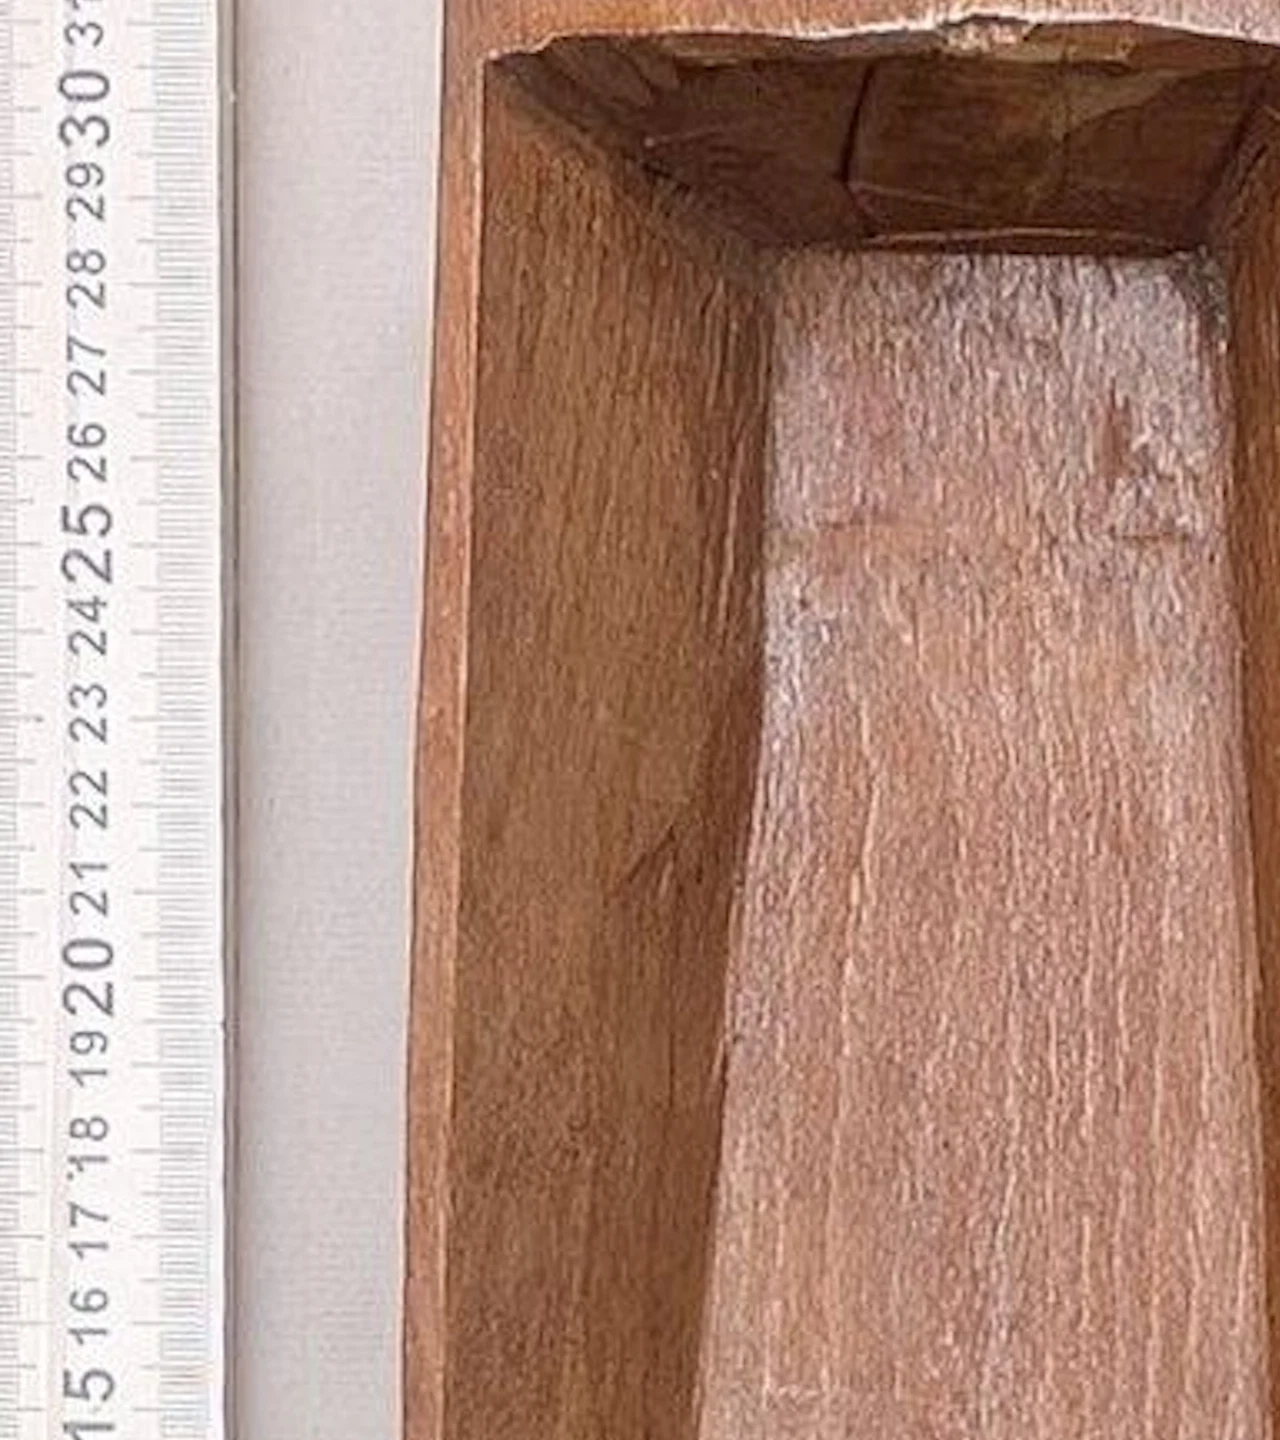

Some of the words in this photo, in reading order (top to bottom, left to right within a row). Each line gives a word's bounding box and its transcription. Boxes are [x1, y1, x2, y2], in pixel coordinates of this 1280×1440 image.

[57, 70, 110, 148] 30
[64, 162, 105, 222] 29
[66, 249, 106, 309] 28
[66, 334, 106, 397] 27
[66, 423, 107, 483] 26
[60, 504, 113, 584] 25
[66, 595, 107, 656] 24
[68, 683, 107, 744] 23
[68, 770, 108, 830] 22
[69, 862, 108, 917] 21
[61, 938, 114, 1017] 20
[67, 1031, 108, 1087] 19
[67, 1116, 109, 1172] 18
[68, 1202, 109, 1260] 17
[68, 1288, 109, 1345] 16
